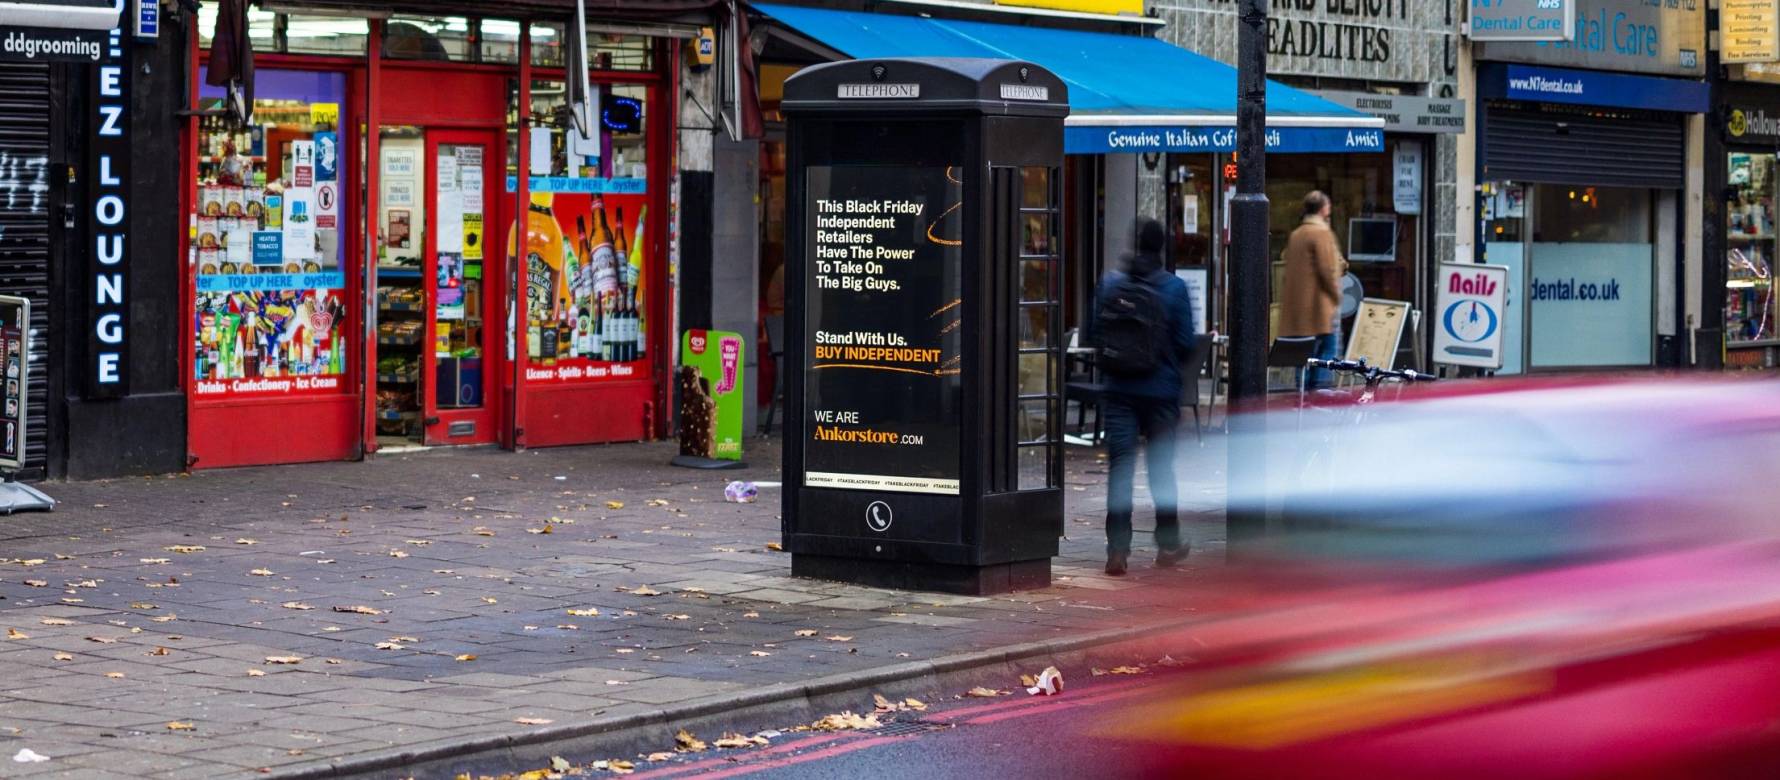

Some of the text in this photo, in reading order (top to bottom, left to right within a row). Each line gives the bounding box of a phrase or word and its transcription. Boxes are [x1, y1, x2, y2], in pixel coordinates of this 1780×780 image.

[1537, 0, 1560, 9] NHS
[1472, 16, 1561, 31] Dental Care
[1266, 18, 1390, 62] EADLITES
[1613, 12, 1658, 57] Care
[4, 32, 101, 60] ddgrooming
[1680, 52, 1697, 67] NHS
[844, 85, 917, 97] TELEPHONE
[1002, 87, 1045, 98] TELEPHONE
[1510, 76, 1584, 94] www.N7dental.co.uk
[1108, 131, 1160, 147] Genuine
[1166, 129, 1209, 147] Italian
[1345, 131, 1379, 147] Amici
[550, 179, 566, 189] TOP
[568, 179, 581, 189] UP
[612, 180, 640, 192] oyster
[817, 200, 923, 216] This Black Friday
[817, 216, 895, 231] Independent
[817, 231, 873, 243] Retailers
[816, 246, 915, 260] Have The Power
[96, 156, 124, 384] LOUNGE
[816, 261, 883, 274] To Take On
[228, 276, 249, 288] TOP
[250, 276, 264, 288] UP
[267, 275, 293, 287] HERE
[303, 274, 337, 288] oyster
[816, 276, 900, 293] The Big Guys.
[1449, 272, 1497, 297] Nails
[815, 331, 908, 346] Stand With Us.
[815, 346, 941, 363] BUY INDEPENDENT
[526, 364, 632, 380] Licence Spirits Beers Wines
[198, 377, 337, 394] Drinks Confectionery Ice Cream
[815, 410, 859, 424] WE ARE
[814, 425, 923, 446] Ankorstore .COM
